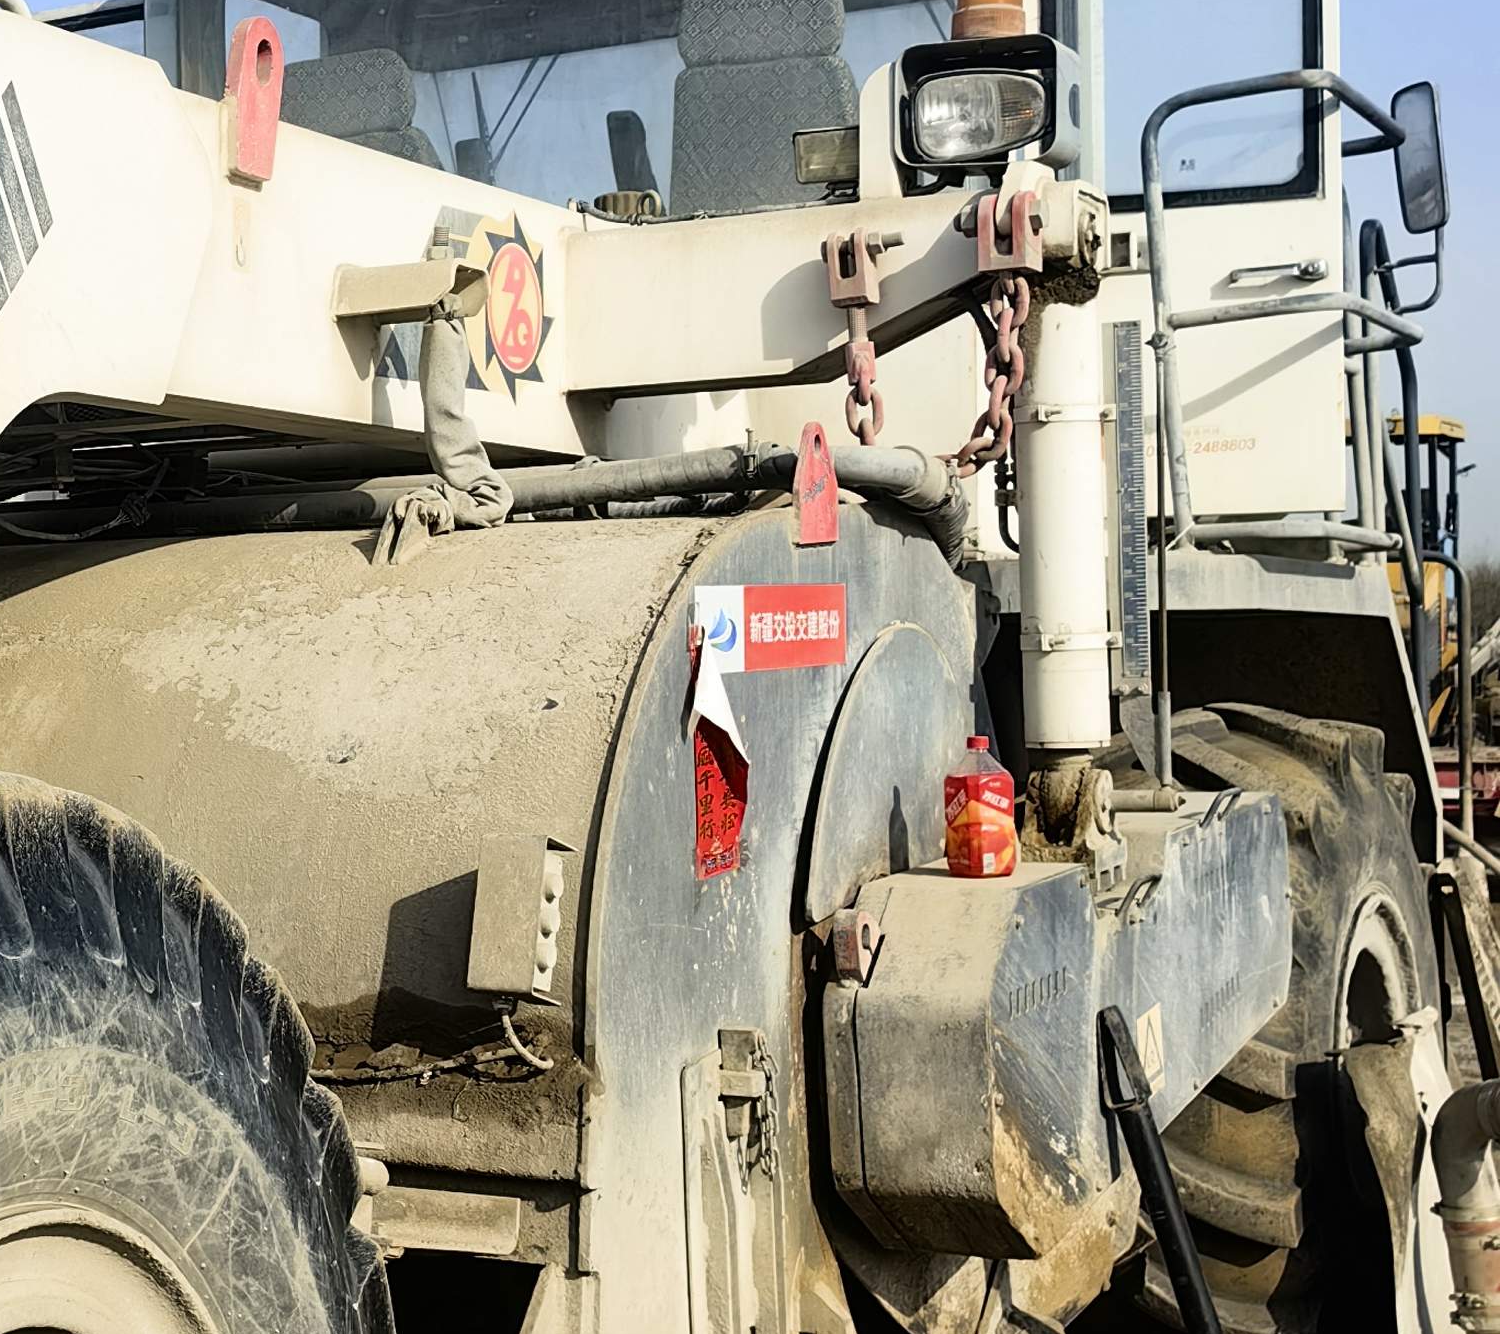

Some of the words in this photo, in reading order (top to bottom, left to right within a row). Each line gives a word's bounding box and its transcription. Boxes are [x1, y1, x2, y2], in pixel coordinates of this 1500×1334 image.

[749, 610, 840, 644] 新疆交投交建股份
